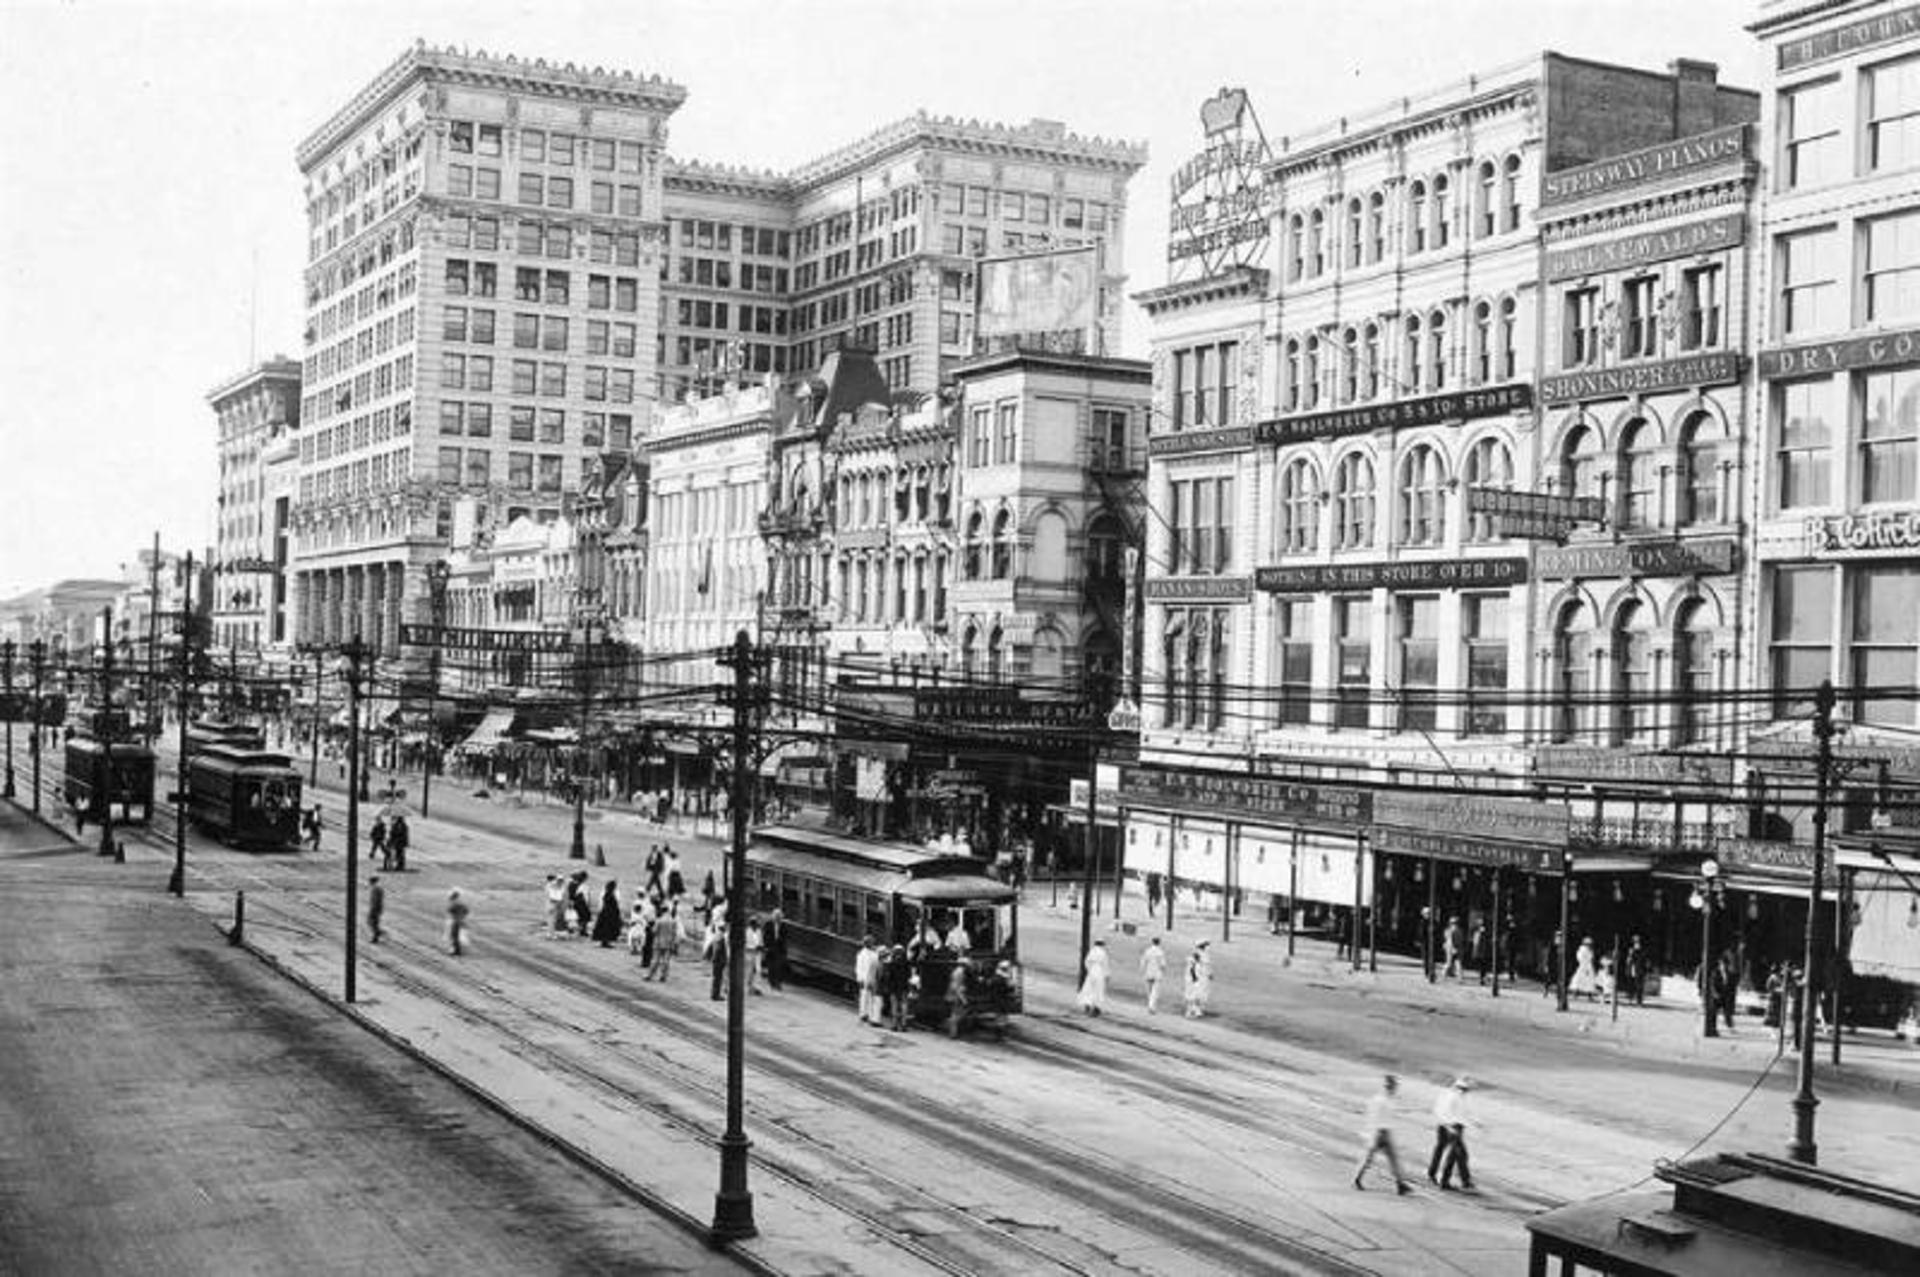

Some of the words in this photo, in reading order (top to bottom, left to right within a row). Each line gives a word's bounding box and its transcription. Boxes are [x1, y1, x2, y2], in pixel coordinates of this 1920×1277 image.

[1546, 154, 1649, 197] STEINWAY
[1655, 136, 1740, 171] PIANOS
[1779, 344, 1843, 372] DRY
[1868, 334, 1920, 361] GO
[1542, 368, 1665, 400] SHONINGER
[1464, 390, 1522, 411] STORE
[1321, 568, 1336, 583] IN
[1342, 566, 1374, 582] THIS
[1382, 564, 1433, 582] STORE
[1439, 561, 1486, 579] OVER
[1538, 548, 1668, 572] REMINGTON
